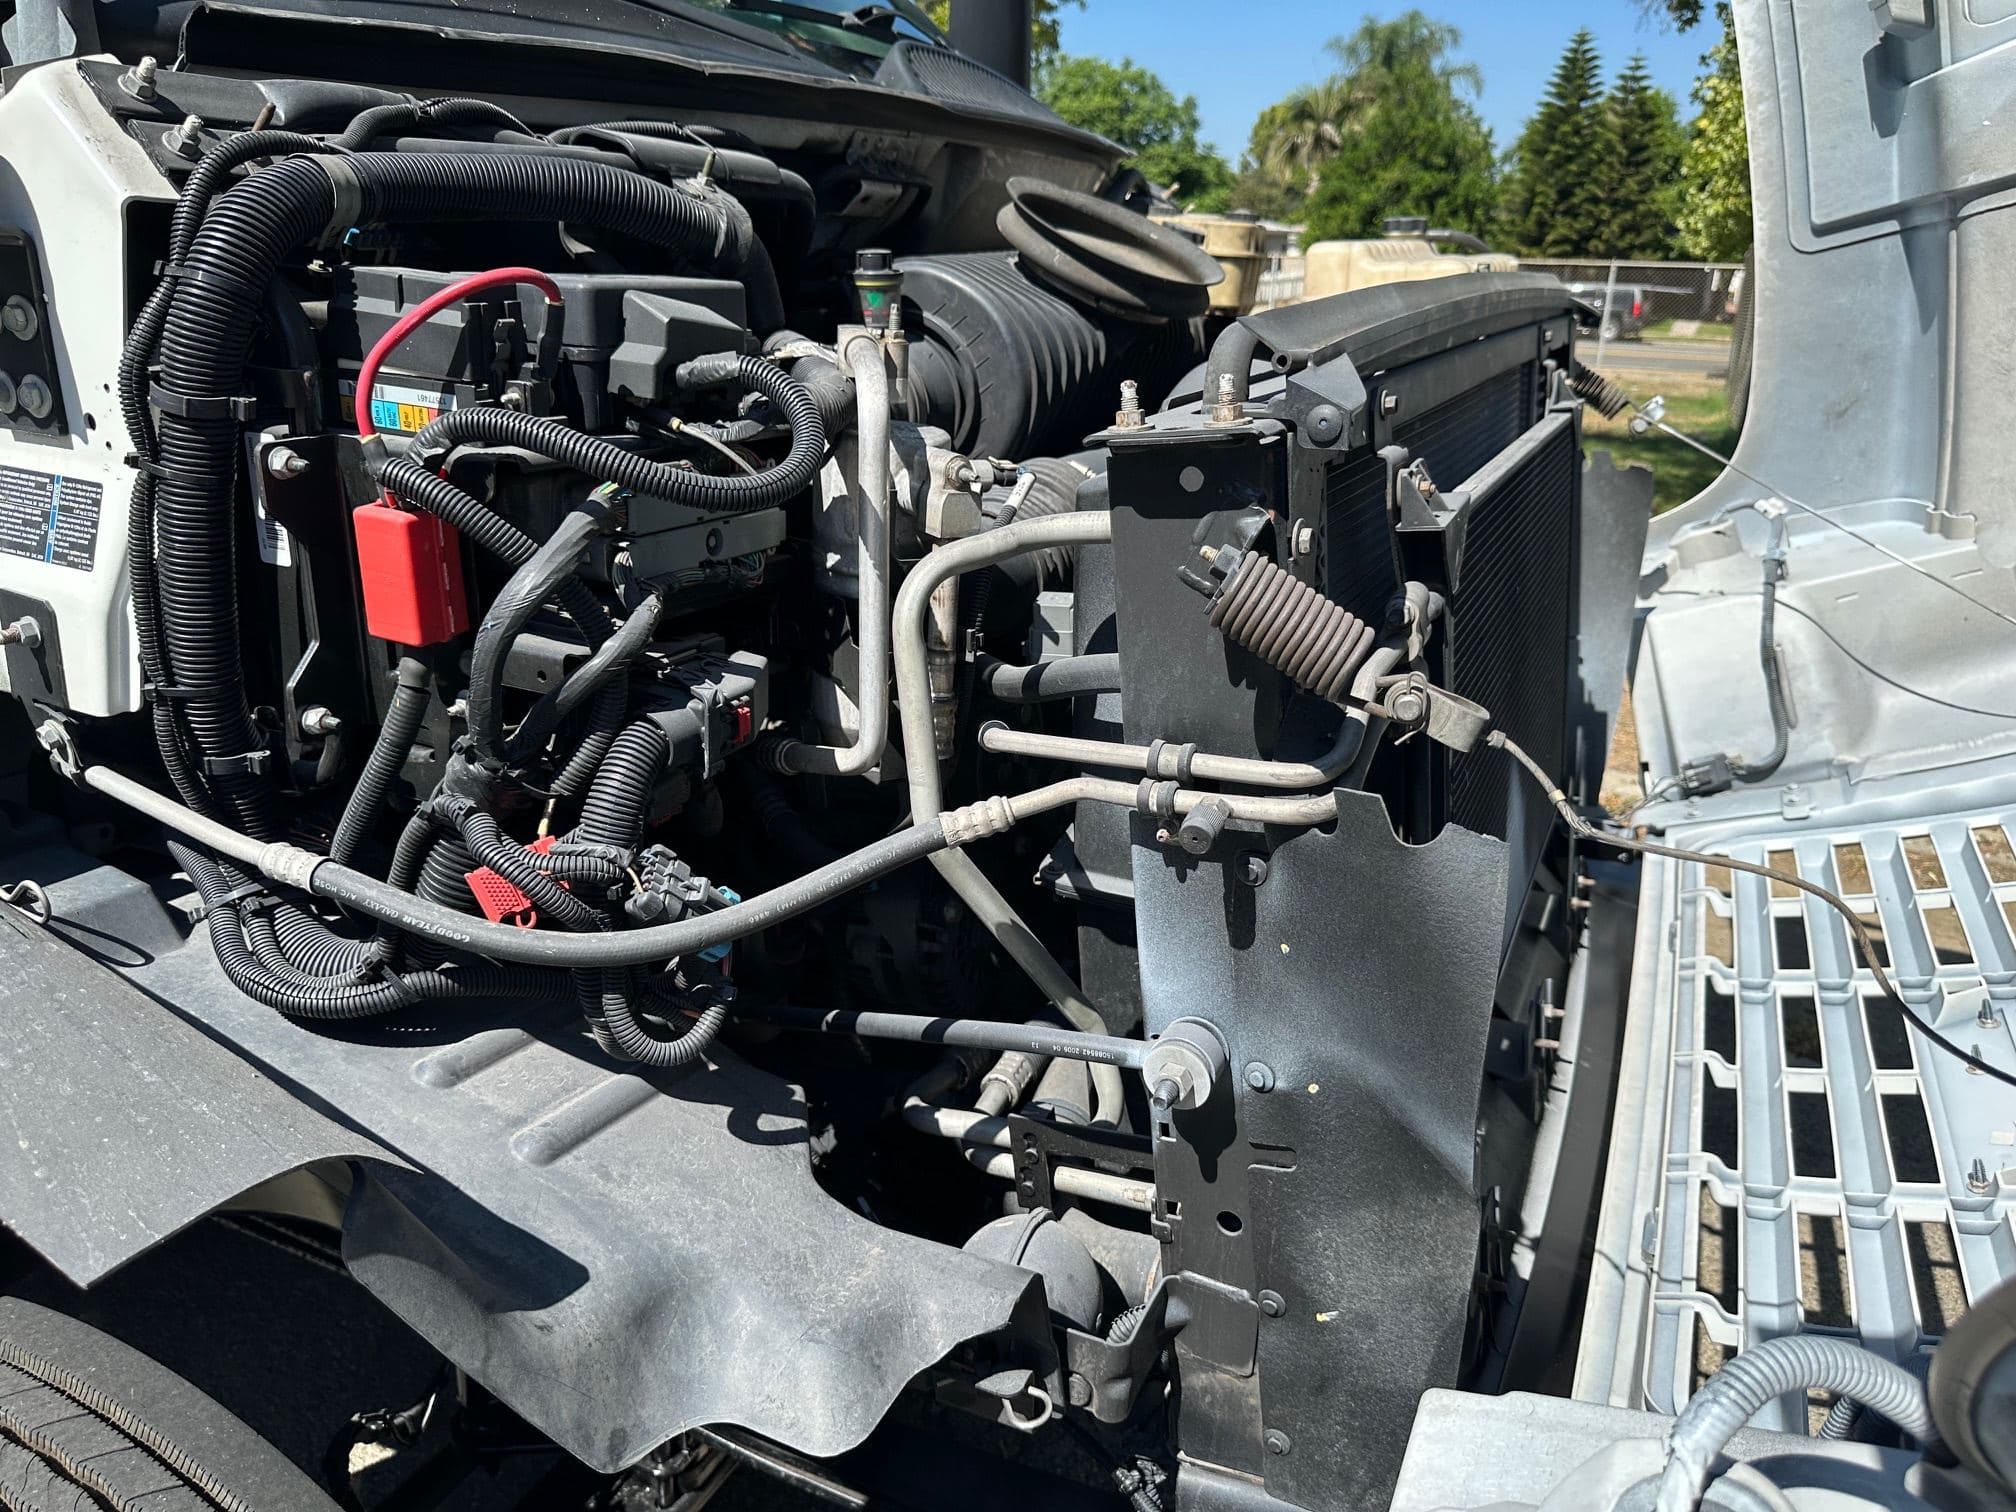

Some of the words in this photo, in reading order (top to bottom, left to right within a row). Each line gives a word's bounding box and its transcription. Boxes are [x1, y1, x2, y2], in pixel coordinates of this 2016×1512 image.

[856, 857, 883, 873] HOSE
[314, 878, 338, 894] HOSE
[829, 871, 853, 887] 13/32
[339, 888, 358, 900] A/C
[362, 898, 399, 918] GALAXY
[776, 899, 797, 913] MM)
[402, 914, 471, 943] GOODYEAR
